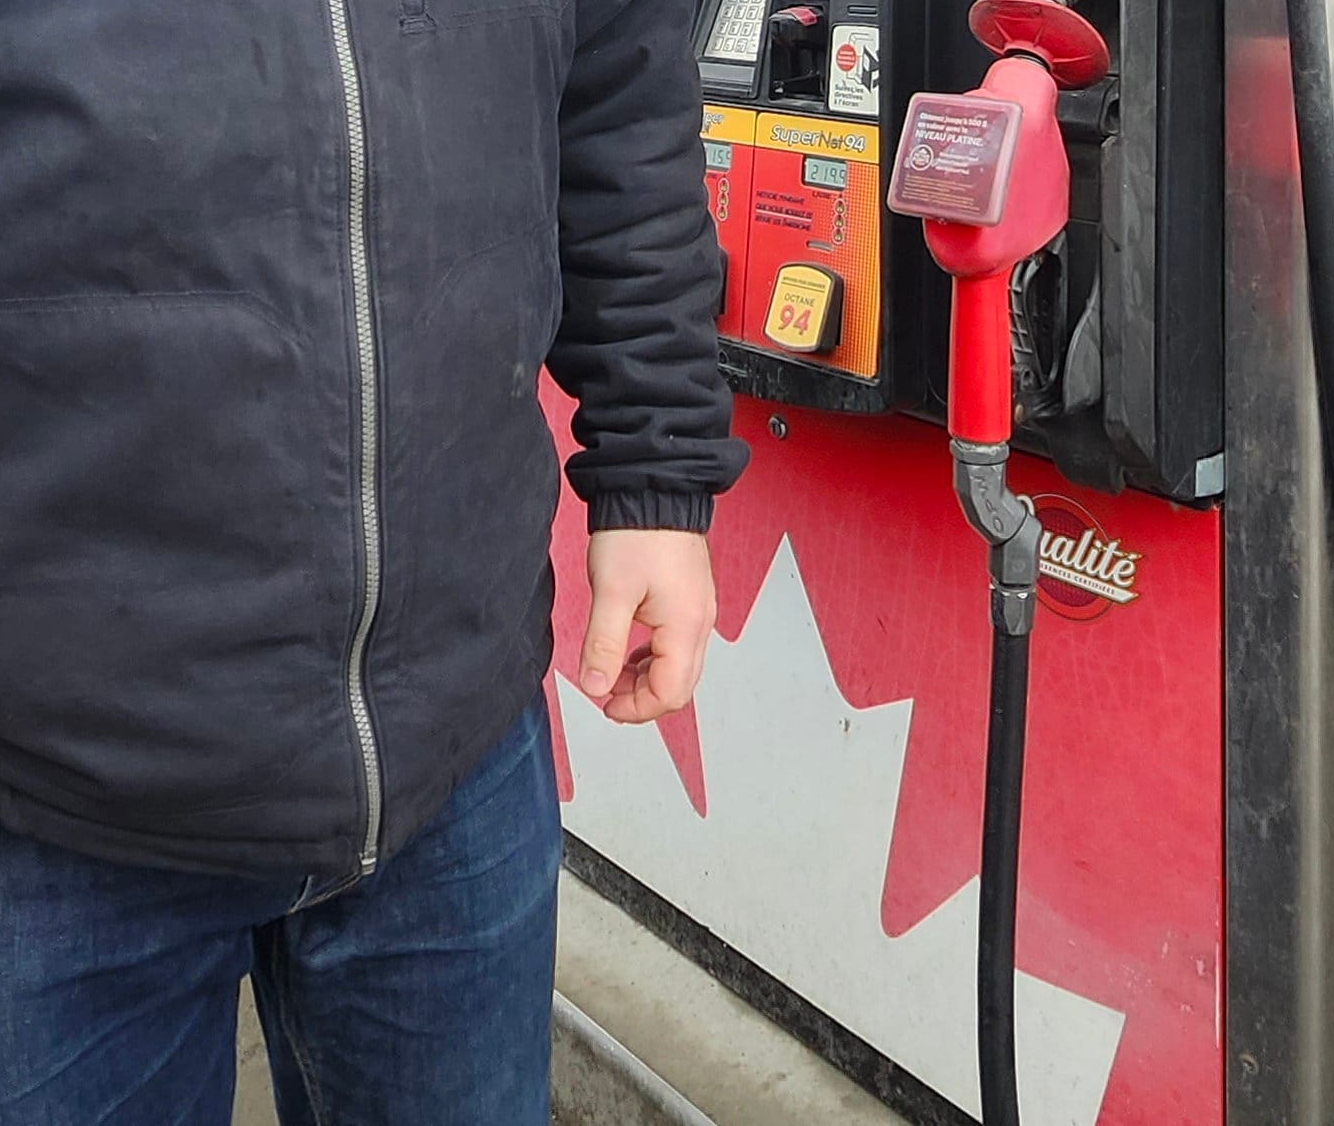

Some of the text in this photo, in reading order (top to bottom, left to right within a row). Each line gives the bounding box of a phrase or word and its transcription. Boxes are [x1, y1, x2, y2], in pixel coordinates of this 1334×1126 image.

[704, 113, 724, 125] per
[915, 129, 946, 141] NIVEAU
[784, 292, 816, 307] OCTANE
[778, 304, 812, 336] 94
[1040, 527, 1143, 587] ualité
